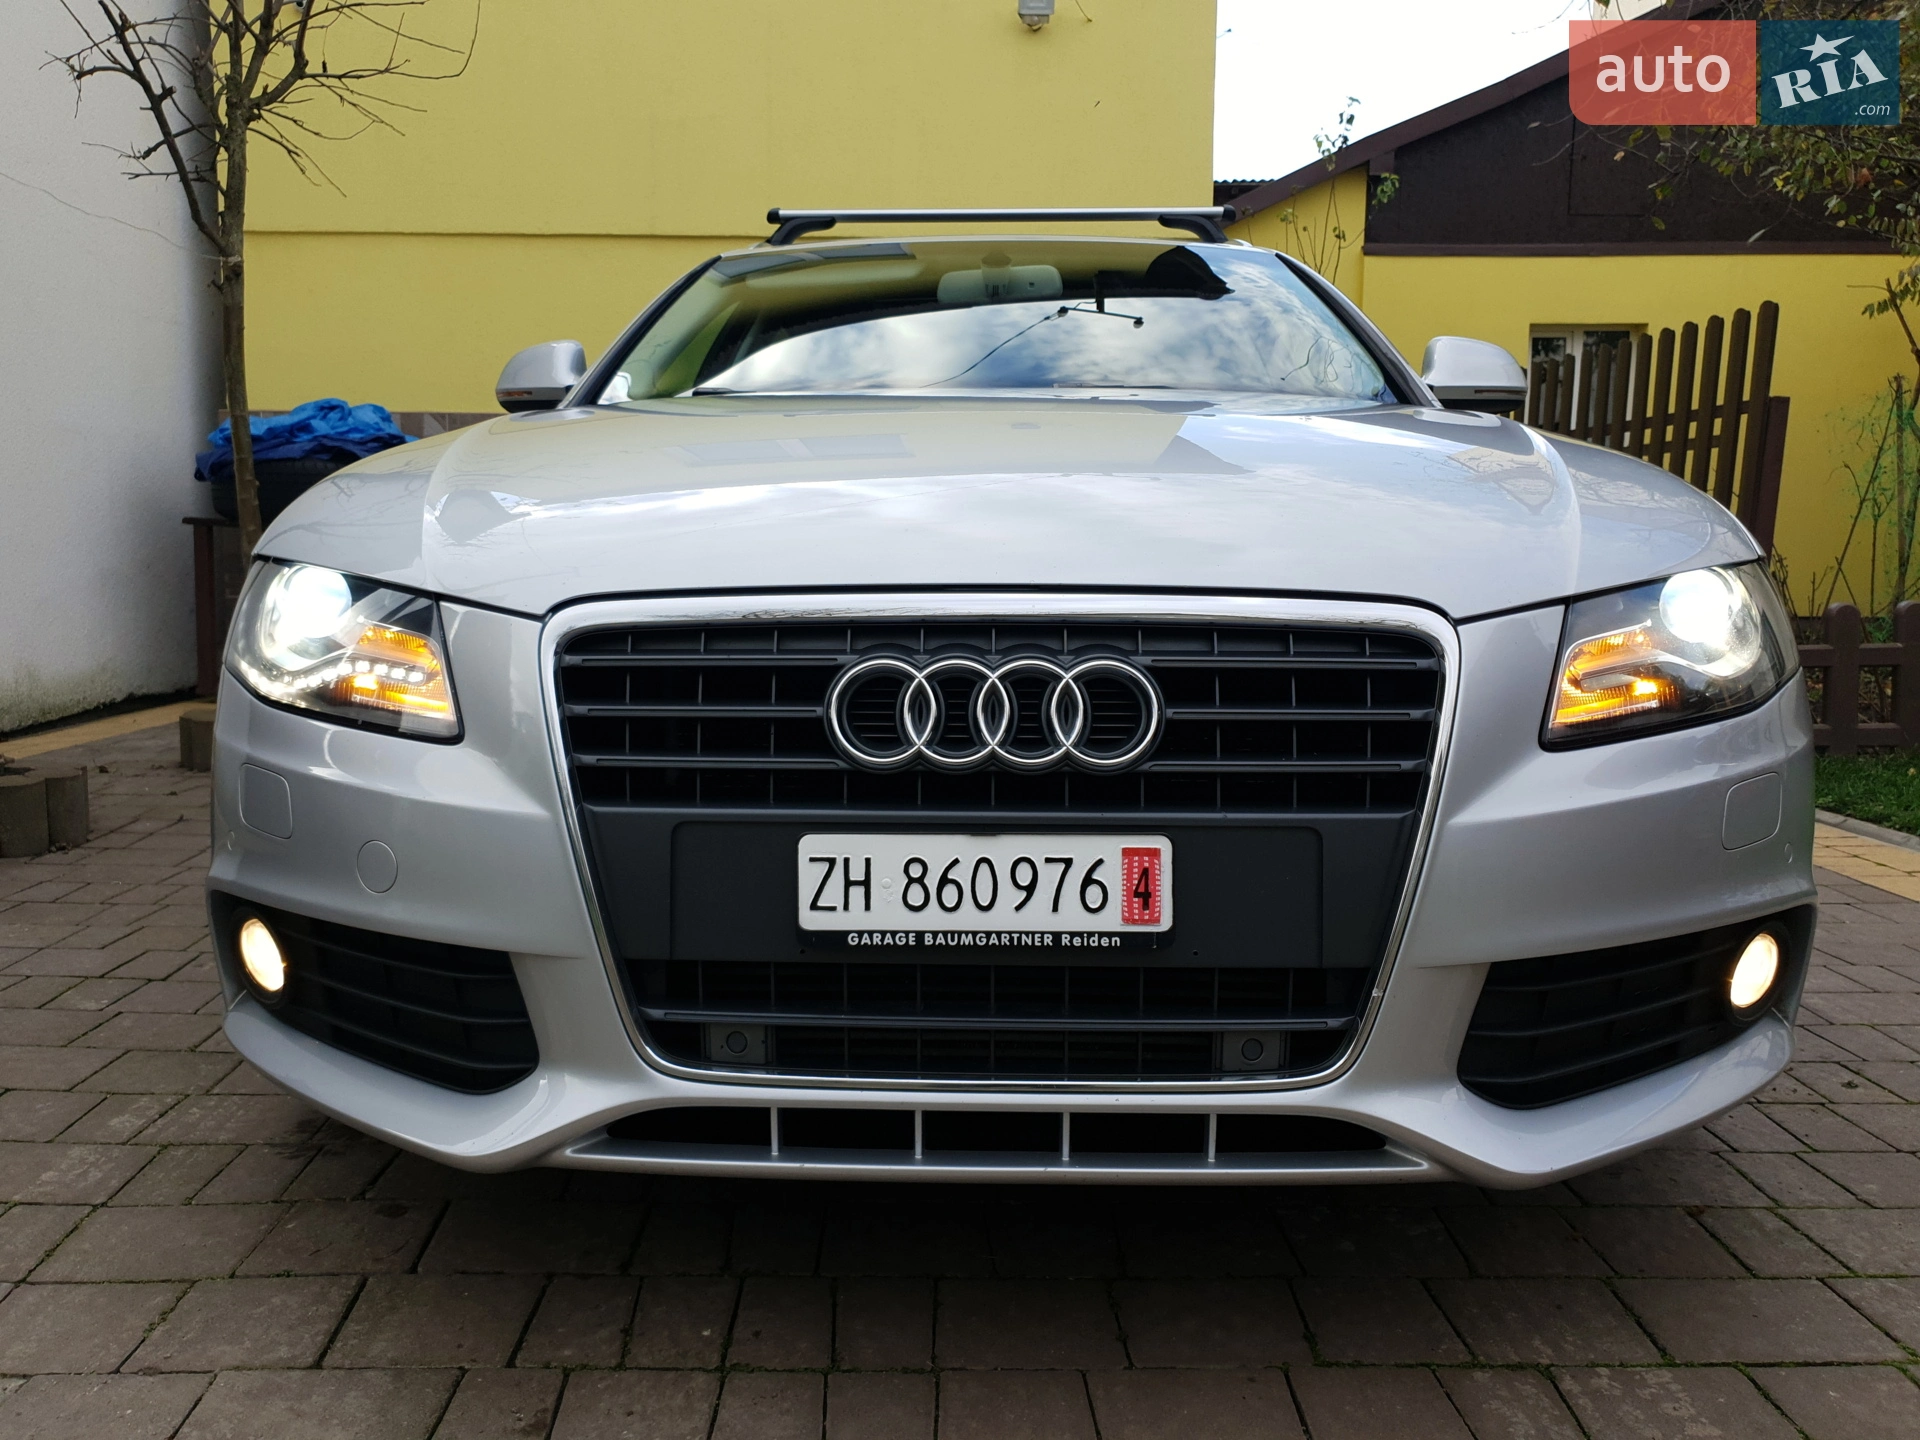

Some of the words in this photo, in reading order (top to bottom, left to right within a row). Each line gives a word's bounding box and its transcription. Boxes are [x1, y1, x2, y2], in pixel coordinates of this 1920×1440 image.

[808, 856, 872, 912] ZH
[1133, 867, 1153, 912] 4
[847, 932, 917, 947] GARAGE
[924, 932, 1054, 948] BAUMGARTNER
[1061, 934, 1121, 948] Reiden
